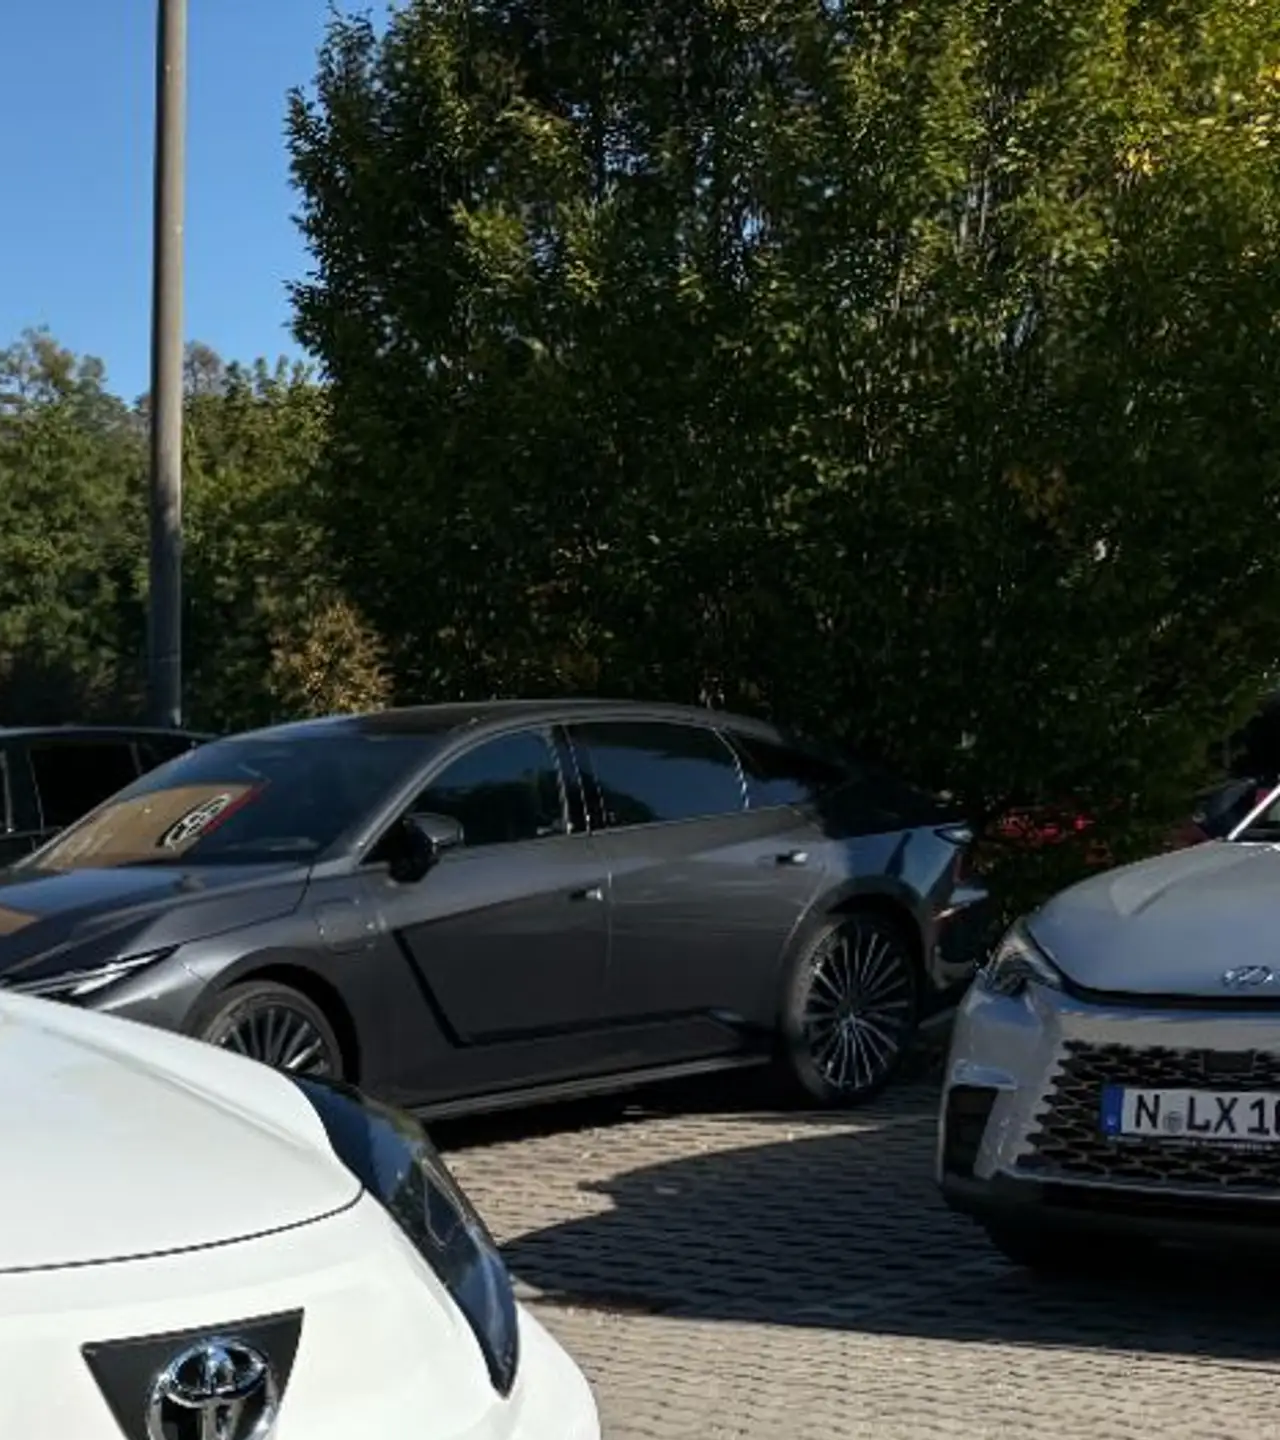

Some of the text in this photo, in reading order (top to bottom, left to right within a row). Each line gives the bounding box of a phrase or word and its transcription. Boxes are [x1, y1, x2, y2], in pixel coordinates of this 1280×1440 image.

[1134, 1093, 1280, 1136] N LX 1
